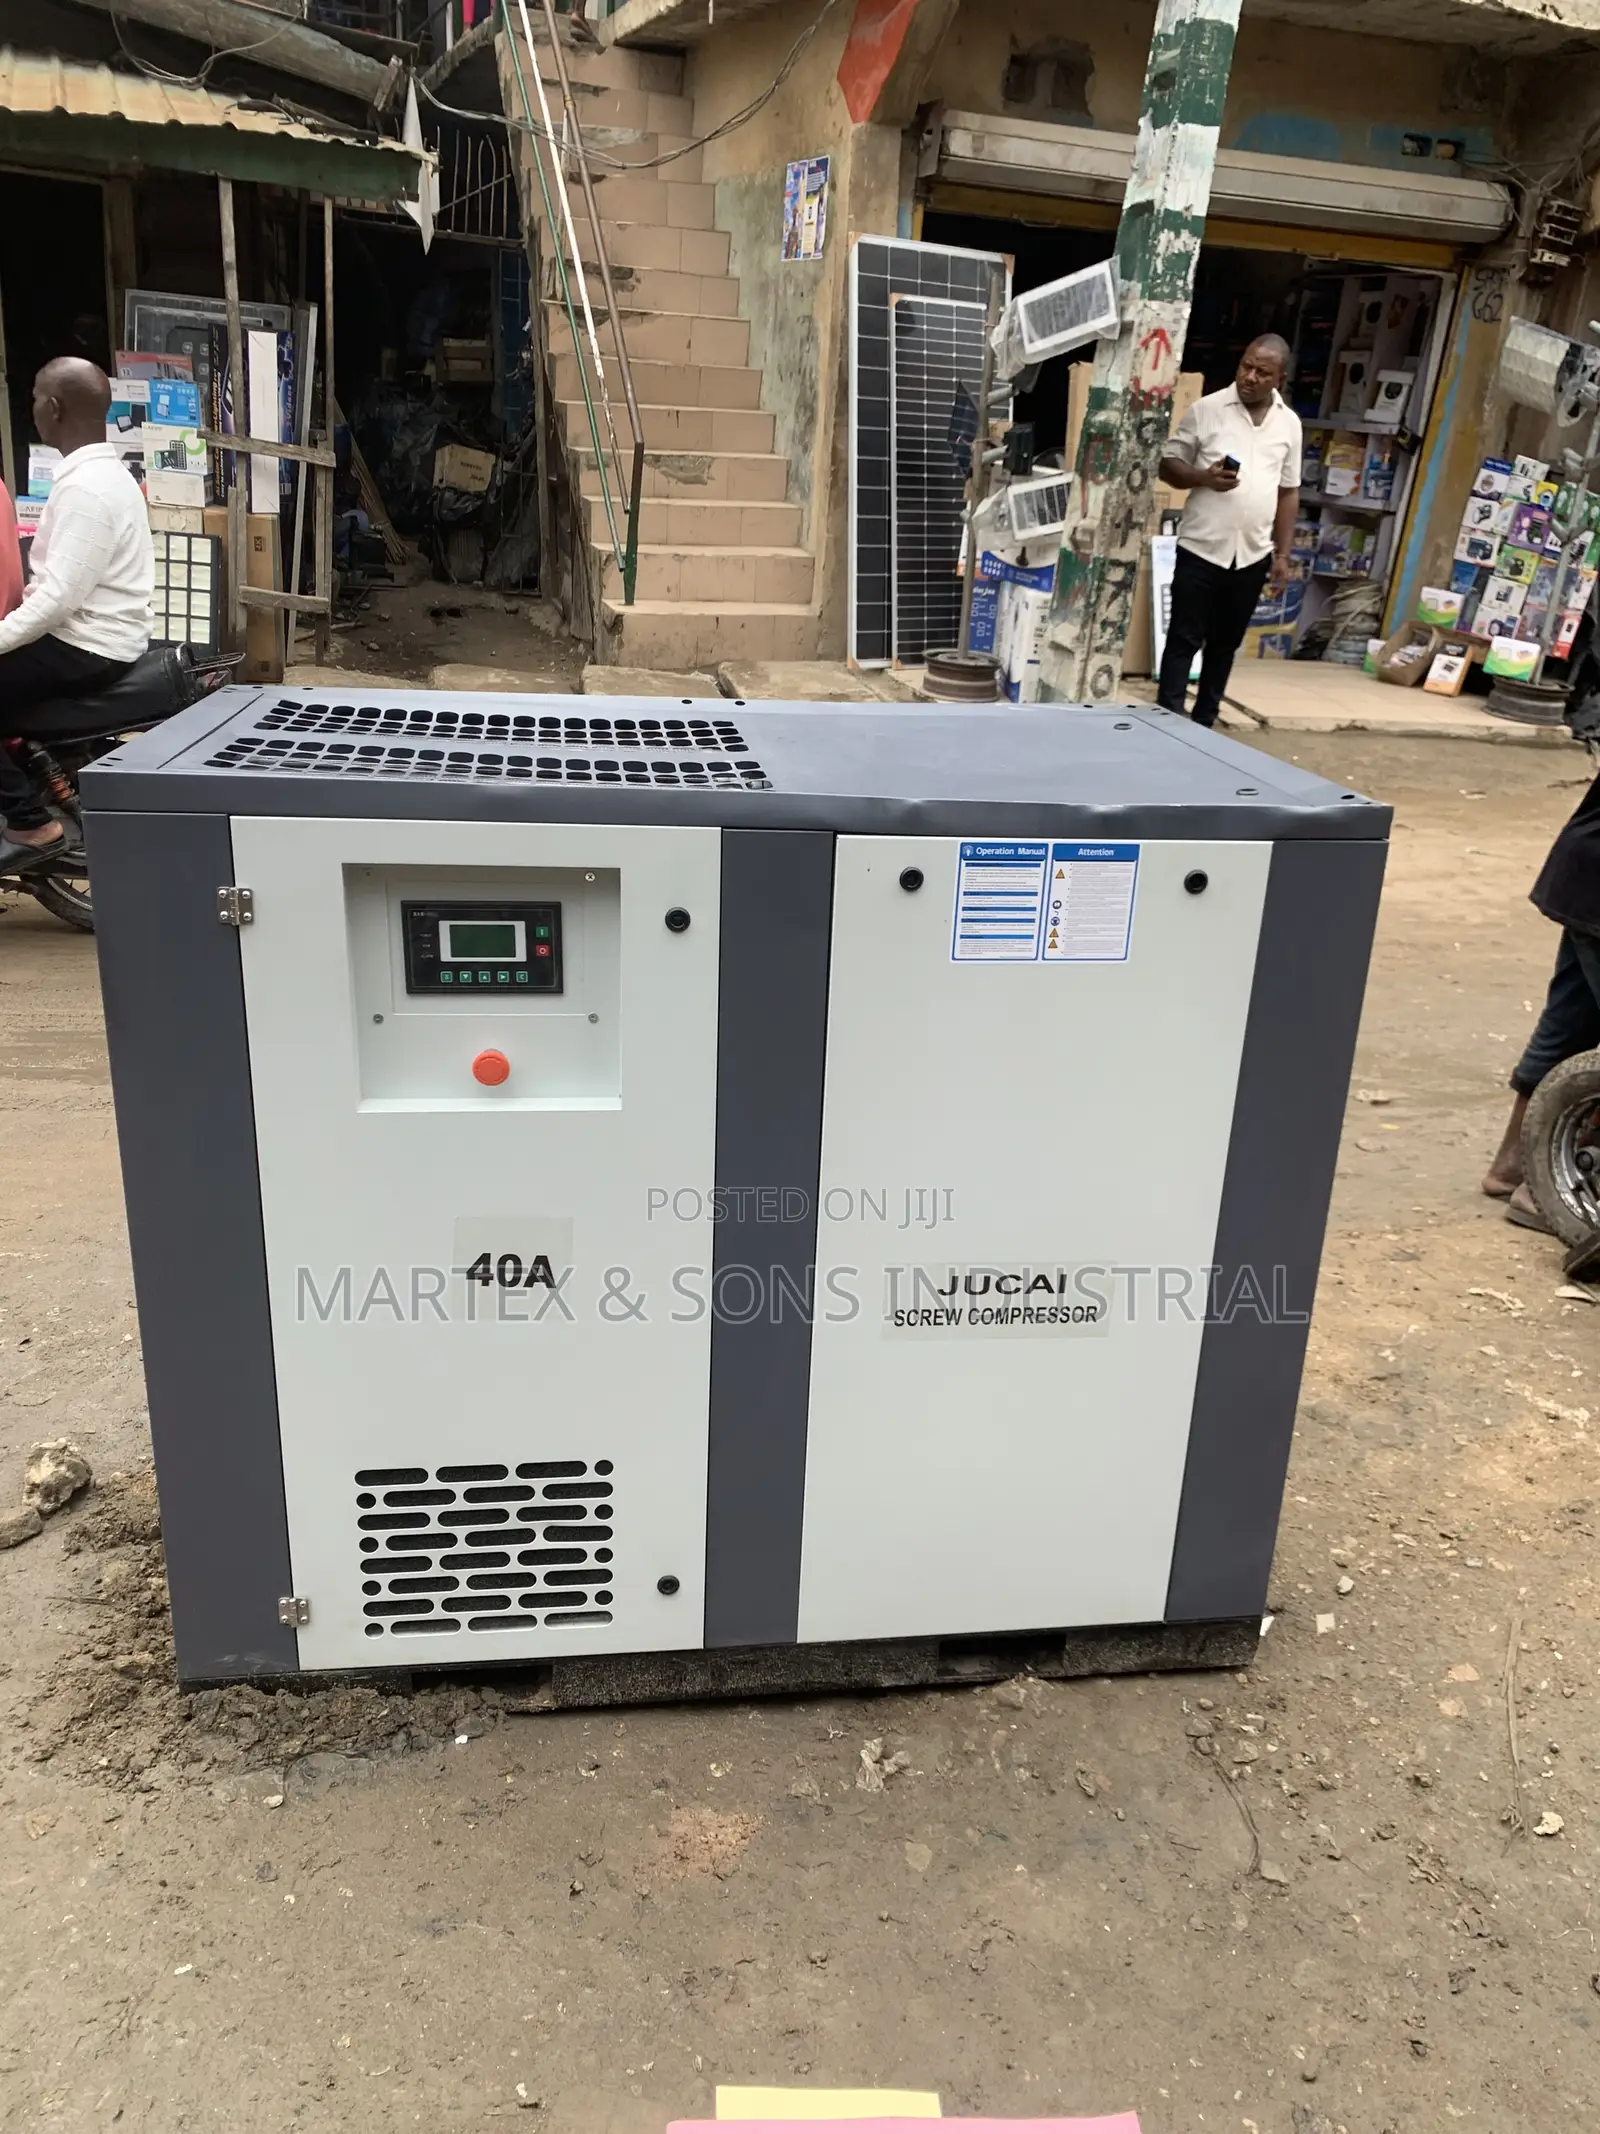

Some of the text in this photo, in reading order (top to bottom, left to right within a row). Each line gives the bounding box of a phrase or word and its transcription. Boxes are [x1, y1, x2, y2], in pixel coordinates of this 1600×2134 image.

[976, 847, 1046, 856] Operation Manual
[1078, 848, 1115, 856] Attention
[465, 1252, 557, 1289] 40A
[937, 1273, 1067, 1297] JUCAI
[894, 1306, 1099, 1328] SCREW COMPRESSOR
